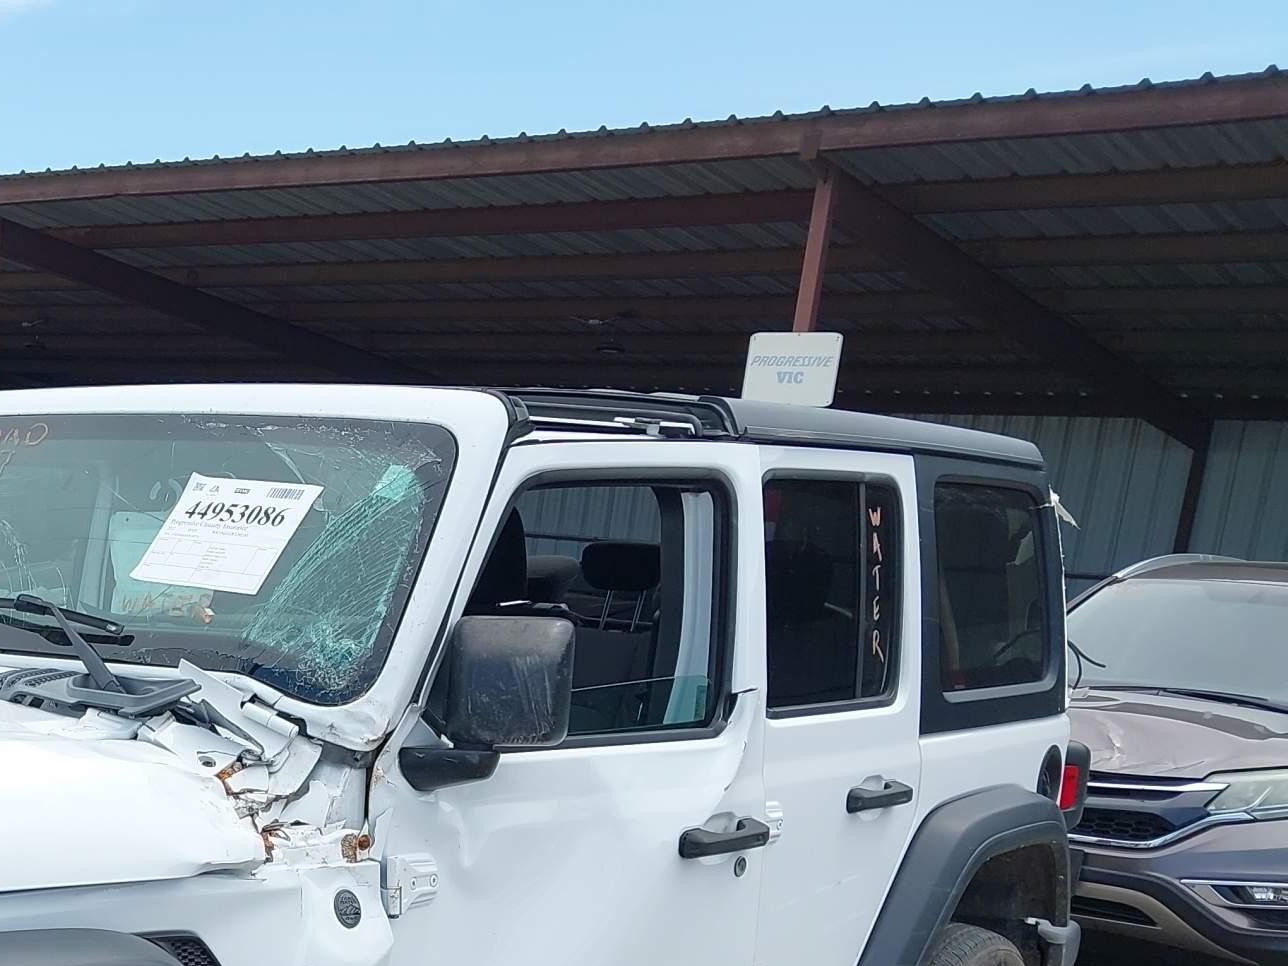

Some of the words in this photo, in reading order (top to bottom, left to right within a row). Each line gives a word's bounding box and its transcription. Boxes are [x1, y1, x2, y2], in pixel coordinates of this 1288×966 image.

[751, 355, 833, 367] PROGRESSIVE
[776, 371, 804, 383] VIC
[185, 500, 289, 527] 44953086
[868, 506, 884, 663] WATER
